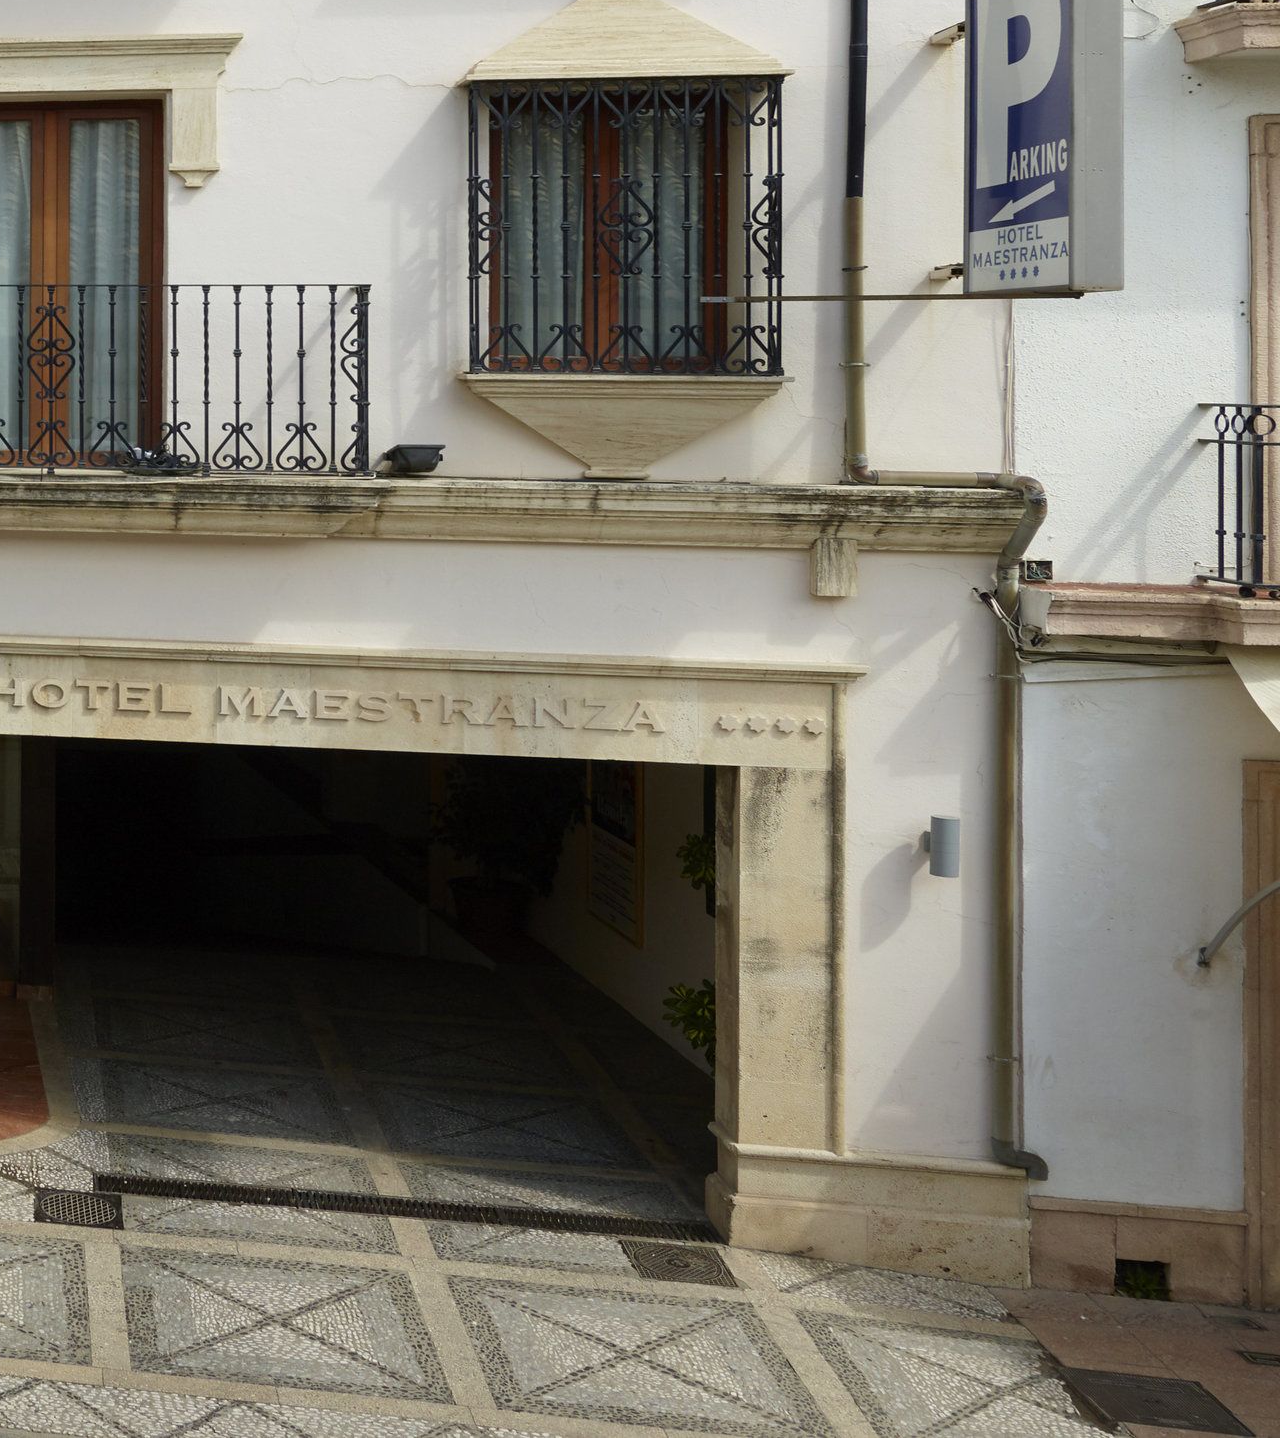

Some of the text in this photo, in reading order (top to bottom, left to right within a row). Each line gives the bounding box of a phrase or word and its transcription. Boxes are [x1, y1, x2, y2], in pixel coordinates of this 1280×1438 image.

[997, 224, 1043, 246] HOTEL
[973, 241, 1069, 268] MAESTRANZA
[218, 685, 666, 734] MAESTRANZA
